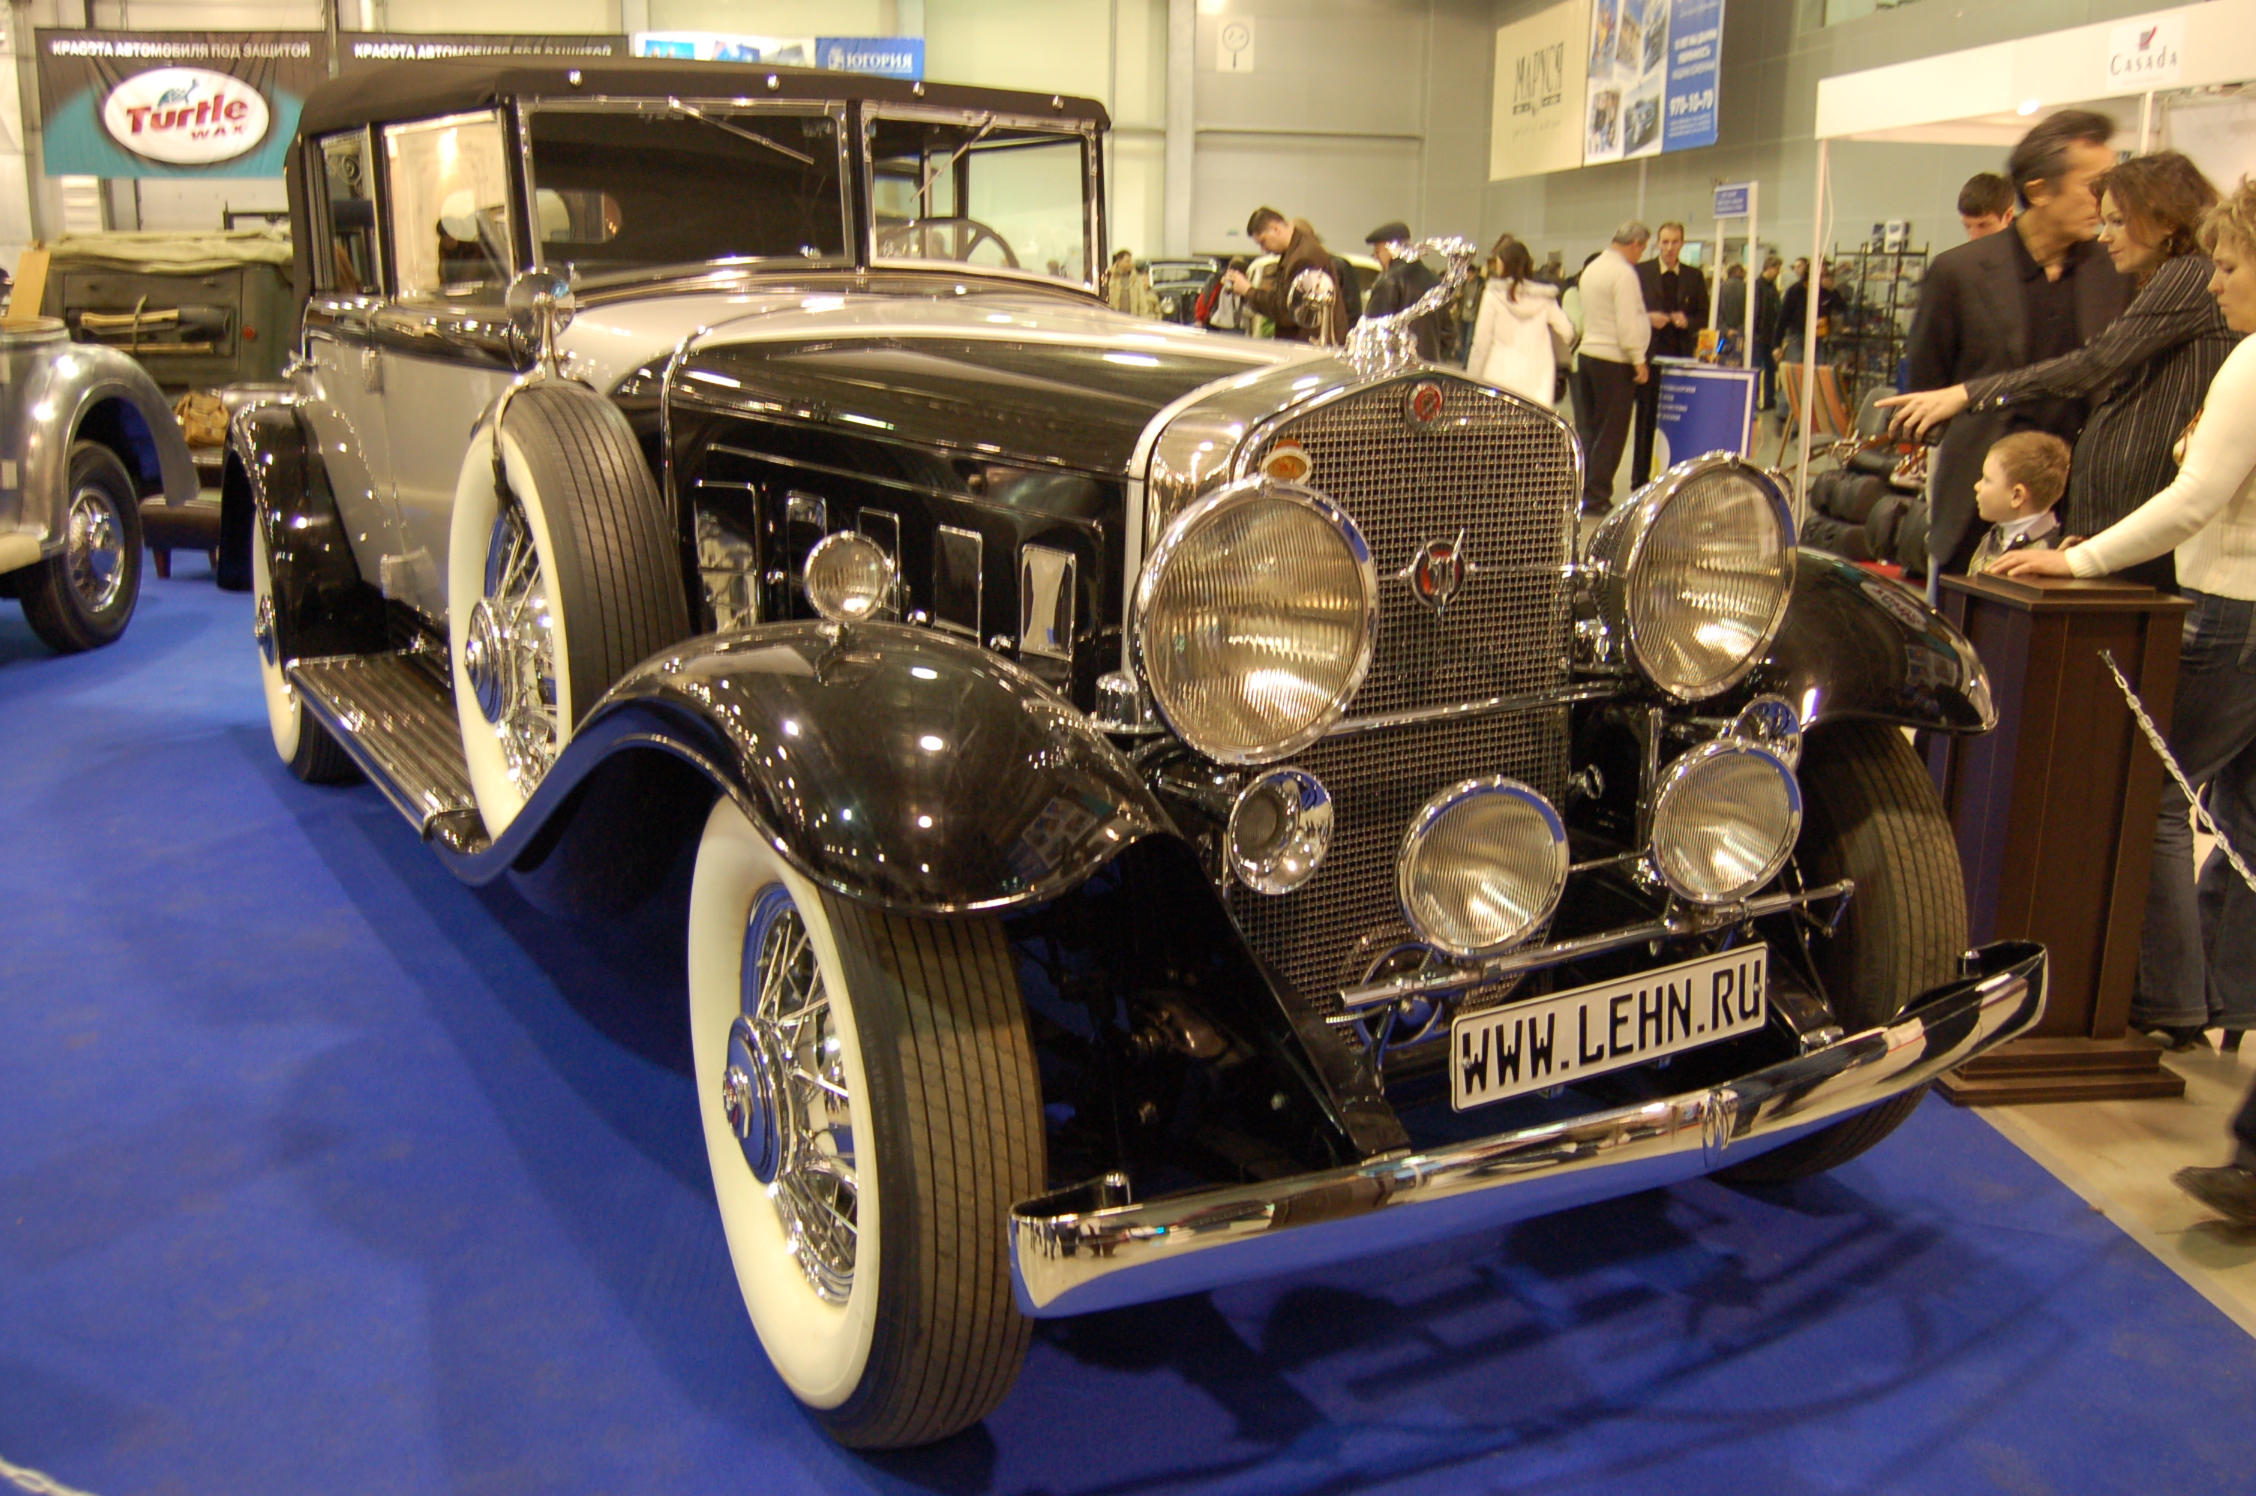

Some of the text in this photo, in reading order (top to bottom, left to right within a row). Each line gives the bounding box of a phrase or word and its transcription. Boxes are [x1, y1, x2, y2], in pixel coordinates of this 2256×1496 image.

[52, 40, 310, 59] КРАСОТА АВТОМОБИЛЯ ПОД ЗАЩИТОЙ
[354, 43, 415, 59] КРАСОТА
[846, 52, 913, 68] ЮГОРИЯ
[2109, 44, 2178, 76] Casada
[126, 93, 248, 137] Turtle
[190, 124, 243, 141] WAX
[1462, 959, 1761, 1095] WWW.LEHN.RU
